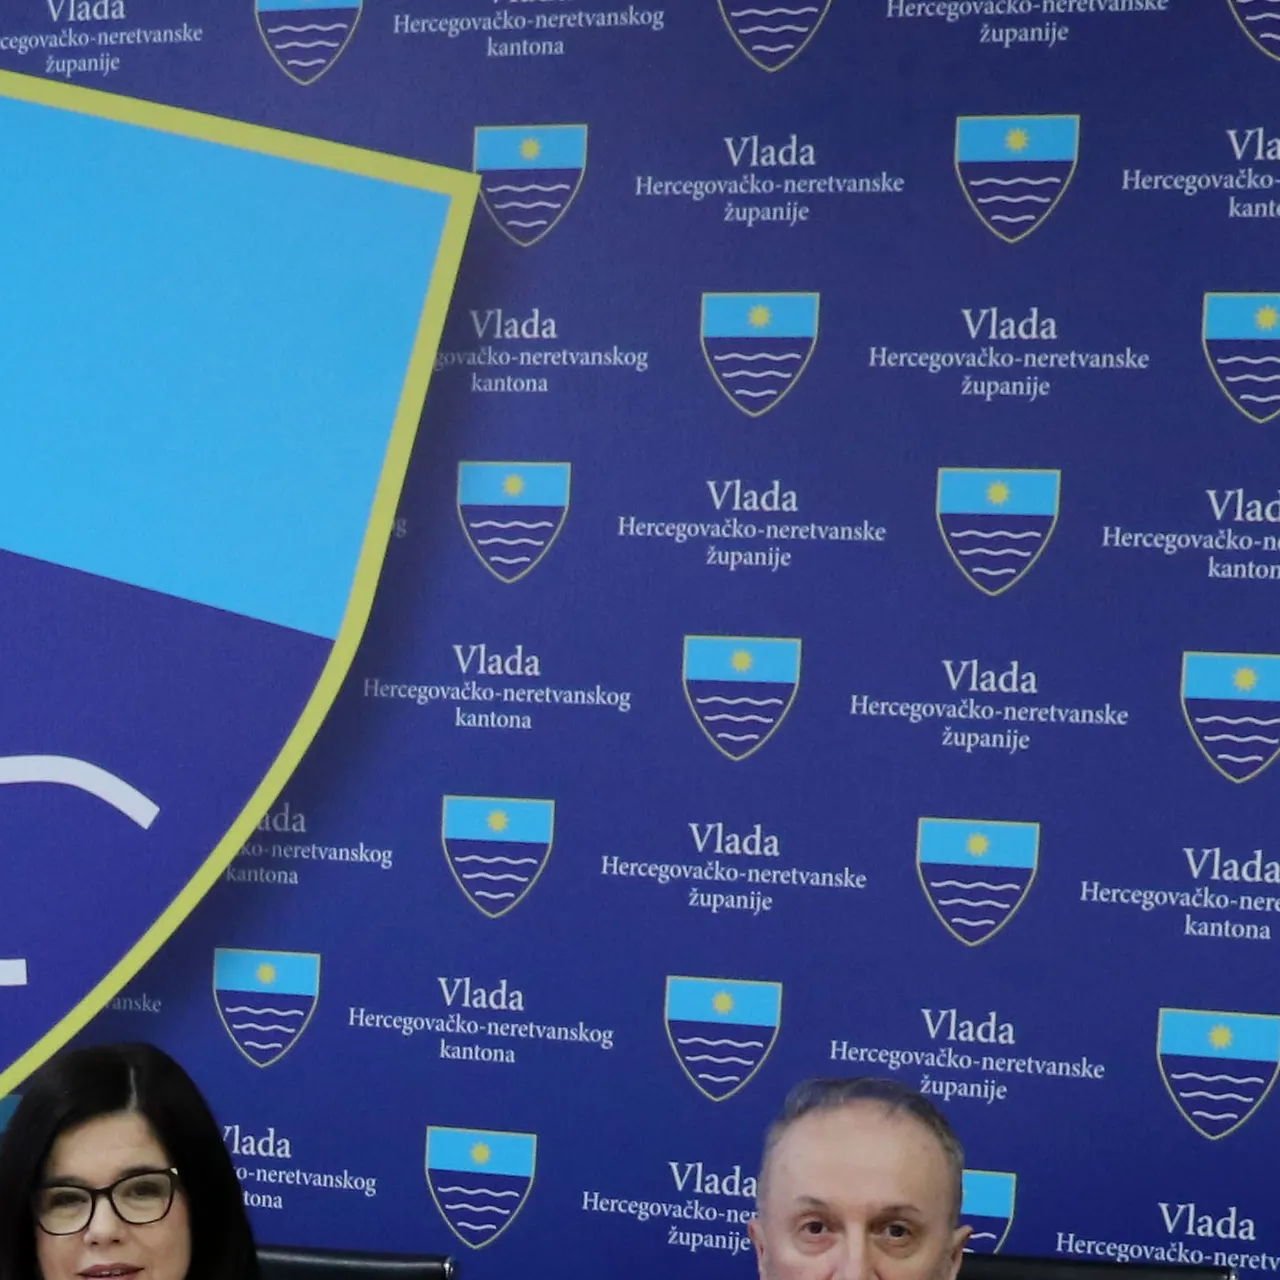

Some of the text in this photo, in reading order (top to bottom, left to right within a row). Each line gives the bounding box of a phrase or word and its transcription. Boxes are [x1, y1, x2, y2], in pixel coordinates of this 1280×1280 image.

[46, 0, 126, 21] Vlada
[394, 5, 664, 37] Hercegovačko-neretvanskog
[488, 36, 563, 56] kantona
[980, 22, 1069, 48] županije
[47, 53, 119, 76] županije
[724, 134, 816, 166] Vlada
[1226, 127, 1280, 160] Vla
[636, 172, 904, 200] Hercegovačko-neretvanske
[1122, 168, 1280, 196] Hercegovačko-
[724, 202, 809, 227] županije
[1229, 196, 1280, 217] kant
[471, 308, 557, 339] Vlada
[961, 307, 1057, 340] Vlada
[434, 346, 648, 372] govačko-neretvanskog
[869, 347, 1149, 373] Hercegovačko-neretvanske
[472, 373, 548, 392] kantona
[962, 376, 1050, 402] županije
[706, 479, 798, 512] Vlada
[1206, 488, 1280, 522] Vlad
[618, 516, 886, 543] Hercegovačko-neretvanske
[1103, 526, 1280, 555] Hercegovačko-n
[707, 546, 791, 572] županije
[1208, 556, 1280, 579] kanton
[452, 644, 540, 676] Vlada
[942, 659, 1037, 693] Vlada
[365, 679, 630, 712] Hercegovačko-neretvanskog
[850, 695, 1128, 725] Hercegovačko-neretvanske
[455, 707, 531, 729] kantona
[942, 726, 1030, 754] županije
[256, 803, 306, 833] ada
[688, 822, 780, 856] Vlada
[241, 843, 393, 870] o-neretvanskog
[1183, 847, 1280, 883] Vlada
[601, 856, 867, 888] Hercegovačko-neretvanske
[689, 888, 772, 916] županije
[1080, 881, 1280, 912] Hercegovačko-ner
[1185, 914, 1271, 939] kantona
[438, 977, 524, 1011] Vlada
[349, 1007, 614, 1049] Hercegovačko-neretvanskog
[921, 1009, 1015, 1044] Vlada
[440, 1038, 515, 1063] kantona
[830, 1040, 1105, 1079] Hercegovačko-neretvanske
[920, 1075, 1007, 1104] županije
[236, 1167, 376, 1197] o-neretvanskog
[668, 1161, 757, 1198] Vlada
[243, 1191, 282, 1209] tona
[582, 1191, 757, 1224] Hercegovačko-ner
[1158, 1203, 1256, 1240] Vlada
[668, 1225, 750, 1256] županije
[1056, 1232, 1280, 1271] Hercegovačko-neretv
